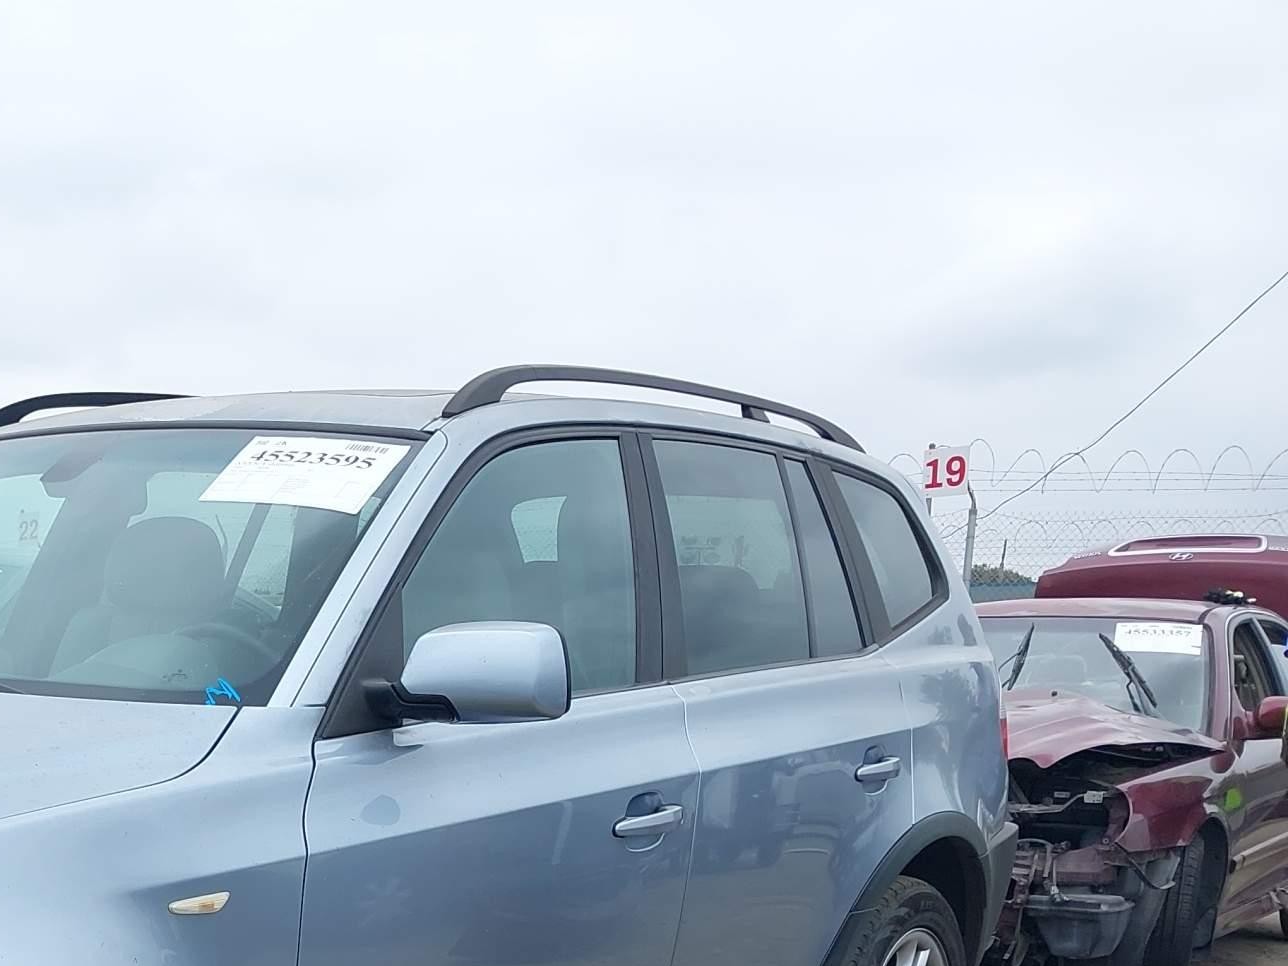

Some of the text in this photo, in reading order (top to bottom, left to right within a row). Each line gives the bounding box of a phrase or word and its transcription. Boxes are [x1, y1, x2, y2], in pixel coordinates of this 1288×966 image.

[251, 450, 377, 470] 45523595
[924, 455, 967, 489] 19
[19, 519, 39, 541] 22
